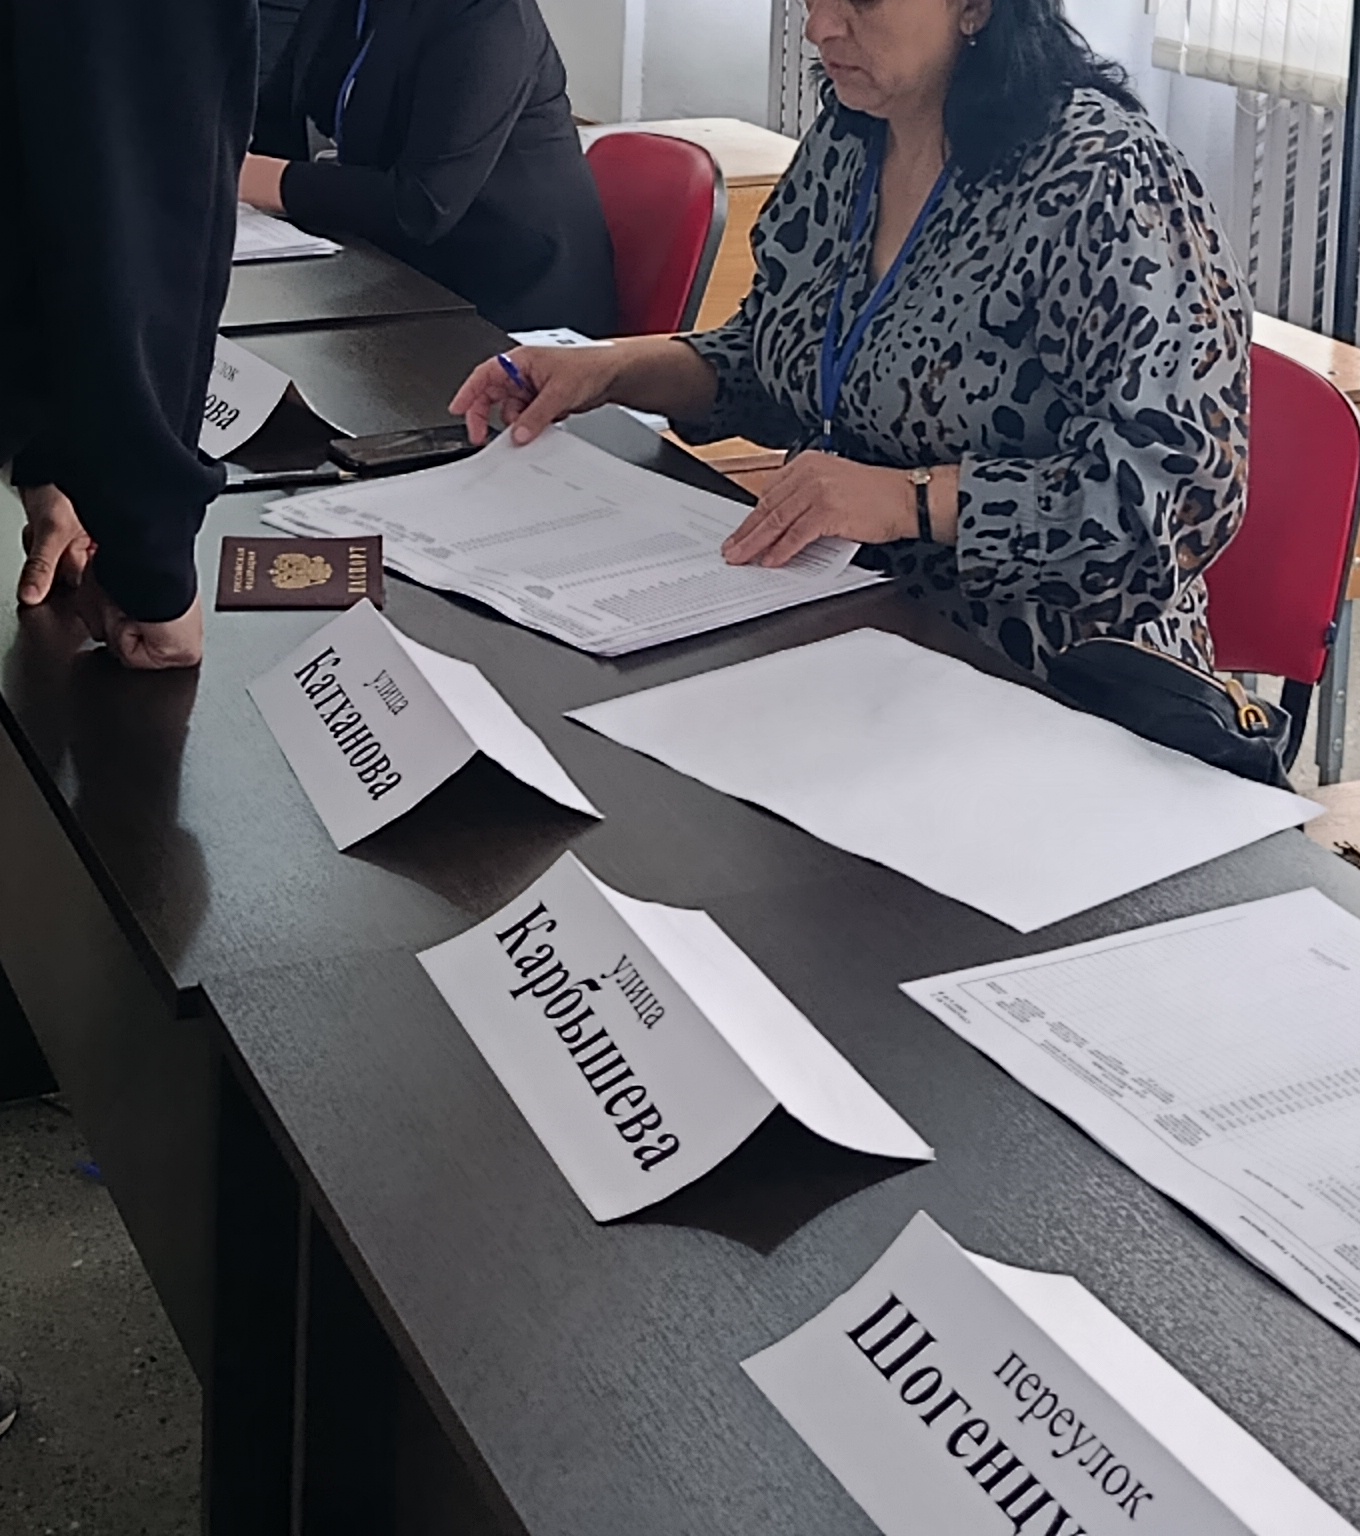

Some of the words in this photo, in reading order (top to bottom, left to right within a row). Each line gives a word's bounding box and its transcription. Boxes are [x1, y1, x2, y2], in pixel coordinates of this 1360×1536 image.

[348, 546, 368, 593] ПАСПОРТ
[293, 645, 402, 802] Катханова
[362, 669, 410, 716] улица
[494, 900, 681, 1172] Карбышева
[599, 954, 666, 1030] улица
[993, 1350, 1155, 1521] переулок
